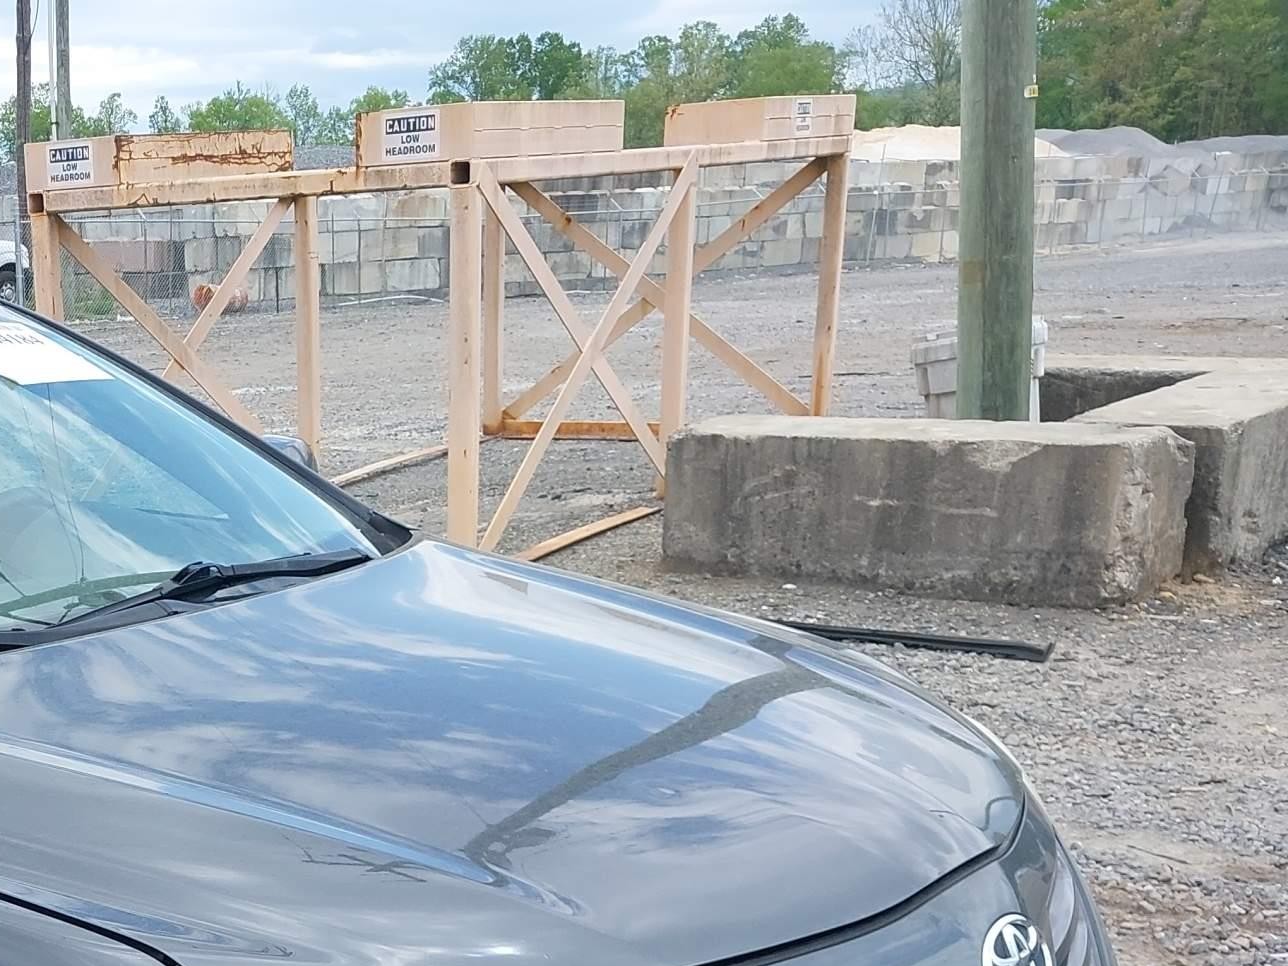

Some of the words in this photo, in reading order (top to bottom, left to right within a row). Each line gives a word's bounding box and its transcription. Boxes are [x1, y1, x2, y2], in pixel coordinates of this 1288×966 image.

[386, 116, 435, 133] CAUTION
[401, 134, 420, 144] LOW
[50, 147, 89, 162] CAUTION
[386, 144, 436, 156] HEADROOM
[62, 162, 78, 172] LOW
[50, 171, 91, 183] HEADROOM
